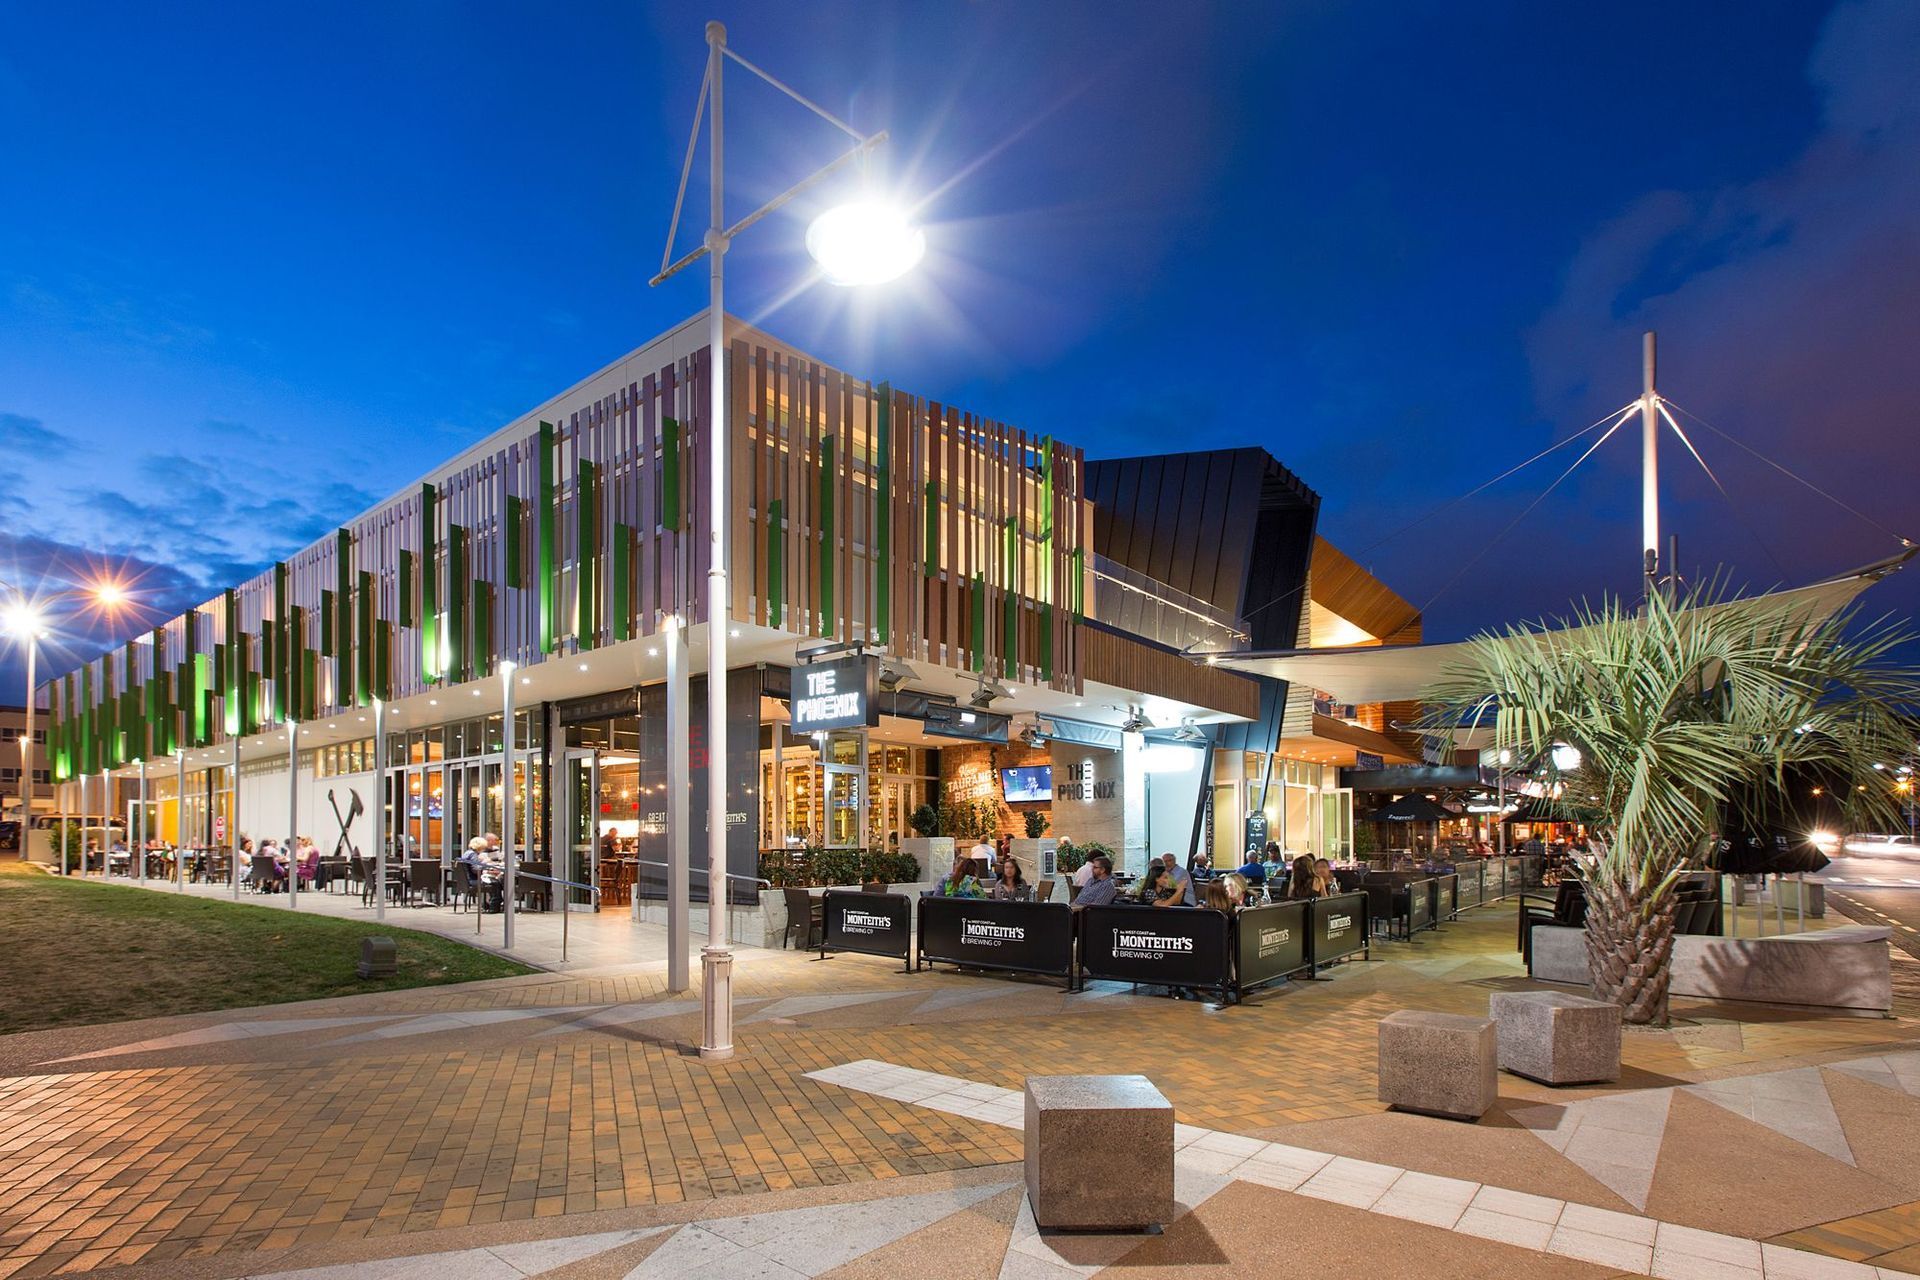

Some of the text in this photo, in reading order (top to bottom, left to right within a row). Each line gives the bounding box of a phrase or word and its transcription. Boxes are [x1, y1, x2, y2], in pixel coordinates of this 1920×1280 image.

[807, 669, 836, 697] THE
[797, 691, 859, 723] PHOENIX
[847, 914, 891, 927] MONTEITH'S
[967, 924, 1025, 939] MONTEITH'S
[967, 937, 993, 946] BREWING
[1119, 935, 1193, 951] MONTEITH'S
[1120, 950, 1153, 959] BREWING
